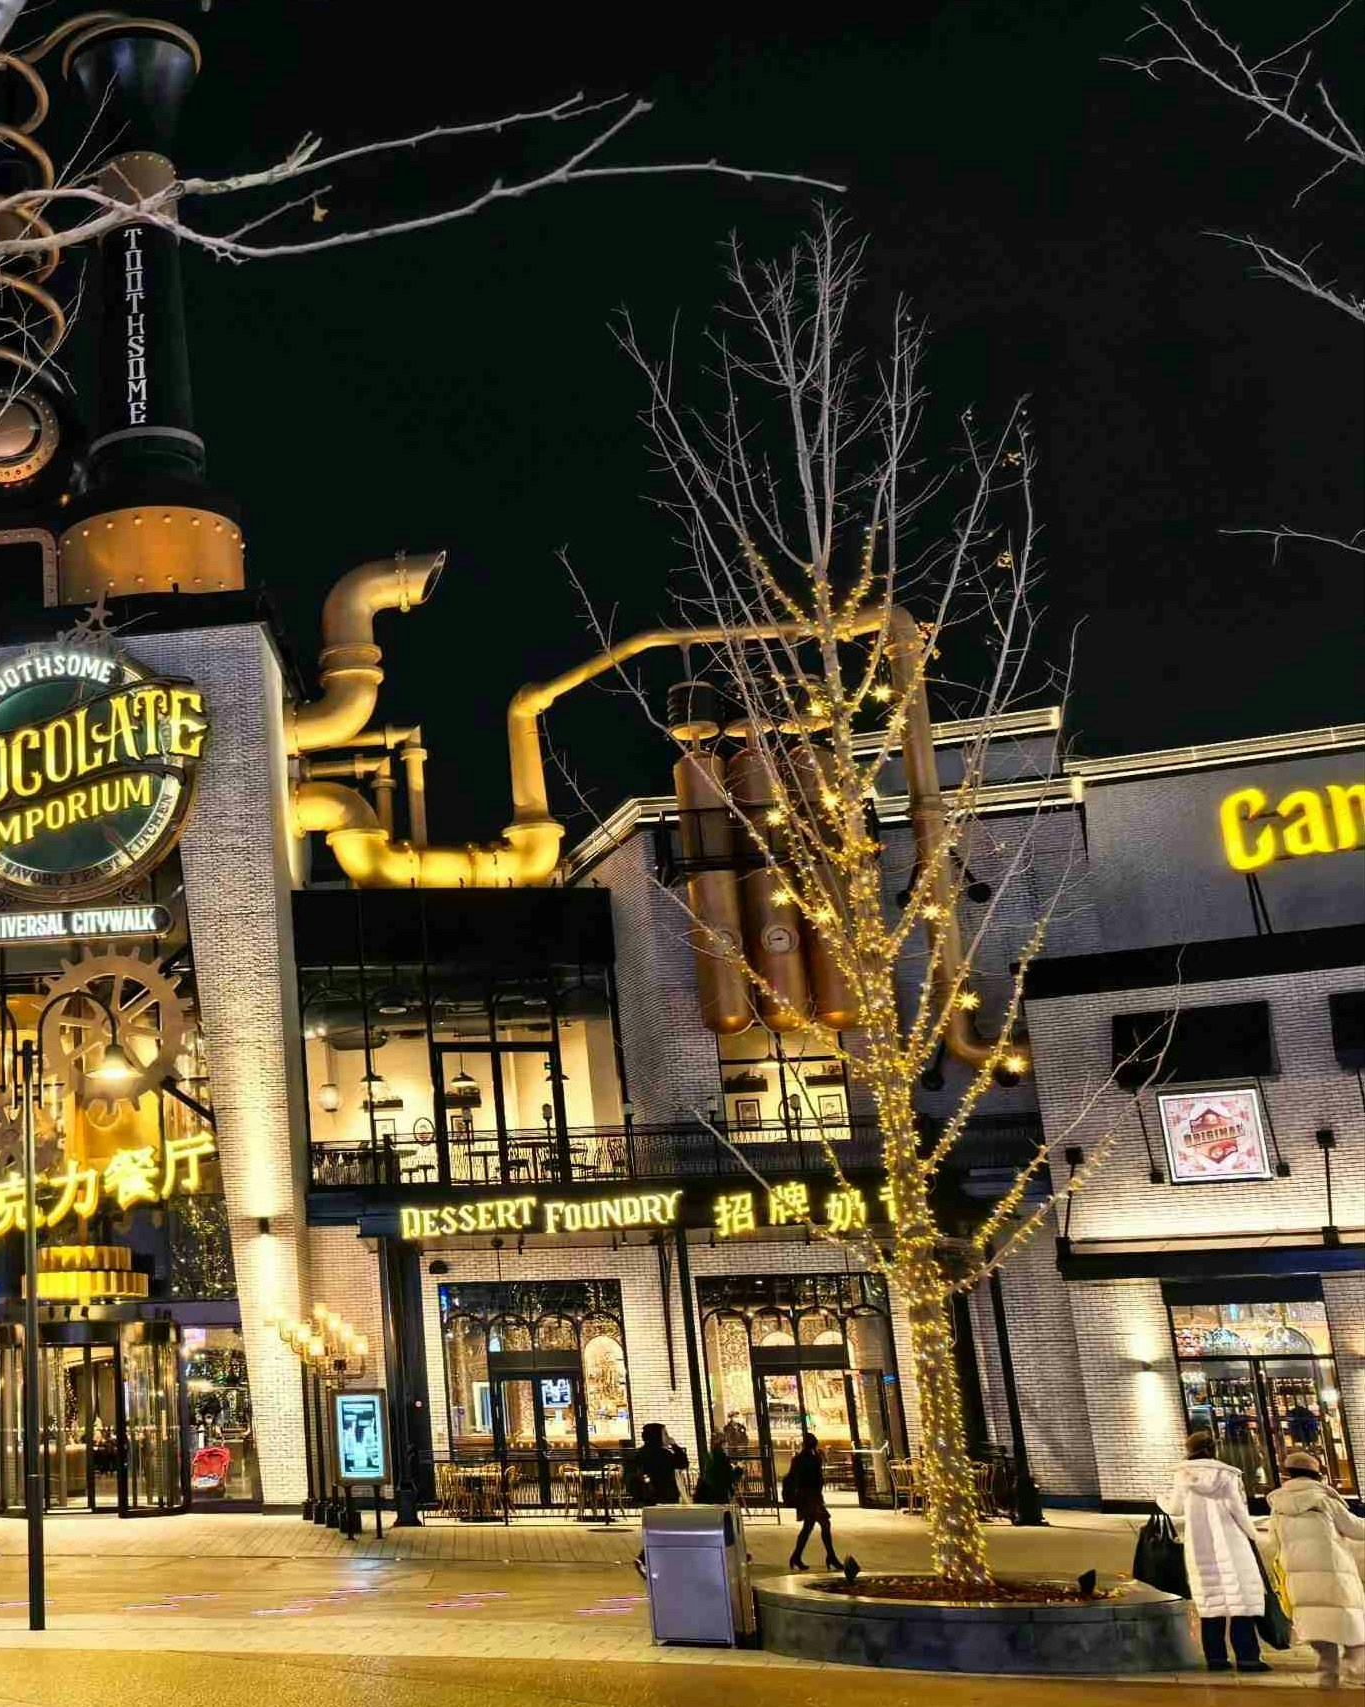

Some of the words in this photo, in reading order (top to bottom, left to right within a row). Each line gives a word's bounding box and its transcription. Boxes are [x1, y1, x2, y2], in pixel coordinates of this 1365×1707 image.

[123, 228, 148, 425] TOOTHSOME
[71, 908, 156, 935] CITYWALK
[400, 1196, 536, 1240] DESSERT
[544, 1190, 683, 1233] FOUNDRY
[713, 1181, 897, 1236] 招牌奶
